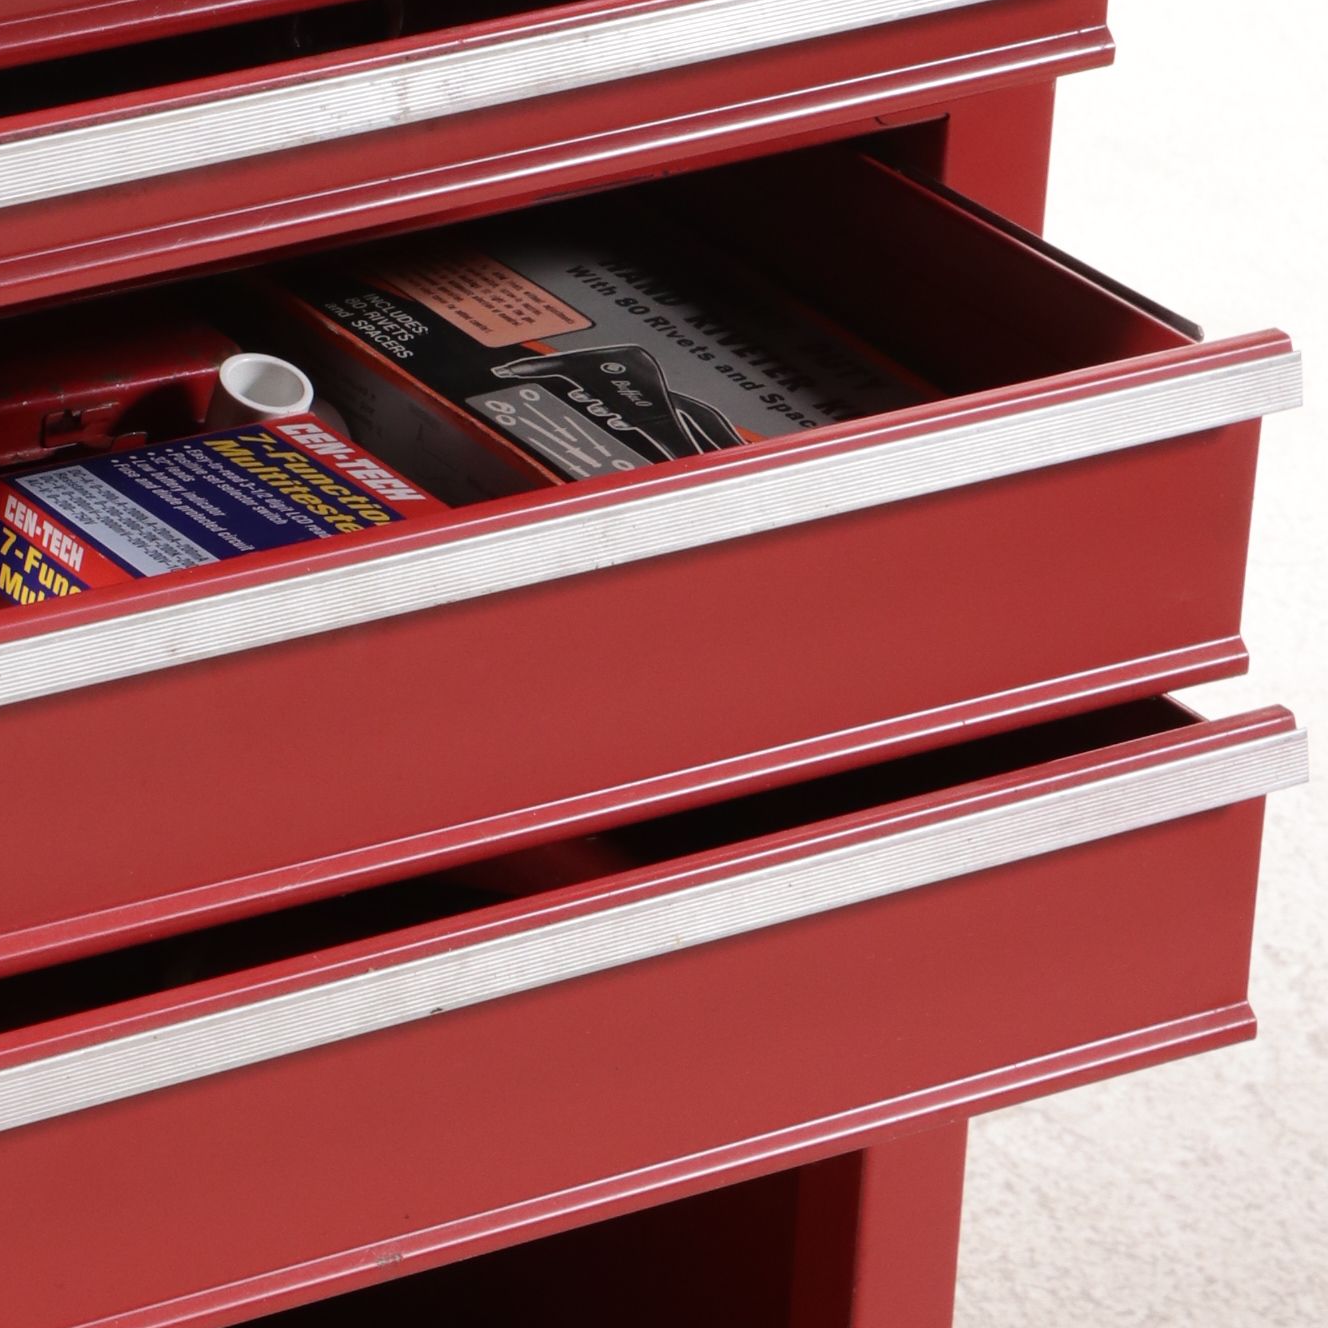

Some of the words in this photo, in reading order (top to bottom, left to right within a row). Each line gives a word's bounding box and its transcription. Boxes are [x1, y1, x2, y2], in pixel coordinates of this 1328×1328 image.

[323, 302, 353, 318] and
[348, 319, 414, 358] SPACERS
[342, 296, 416, 341] 80-RIVETS
[361, 293, 434, 336] INCLUDES:
[565, 264, 616, 297] With
[615, 296, 650, 315] 80
[643, 316, 715, 362] Rivets
[715, 363, 765, 392] and
[238, 432, 393, 527] 7-Functio
[275, 422, 427, 501] CEN-TECH
[3, 495, 84, 572] CEN-TECH
[133, 476, 162, 489] and
[171, 503, 228, 533] protected
[215, 530, 257, 551] circuit
[215, 482, 260, 506] selector
[249, 504, 291, 525] switch
[283, 510, 315, 525] LCD
